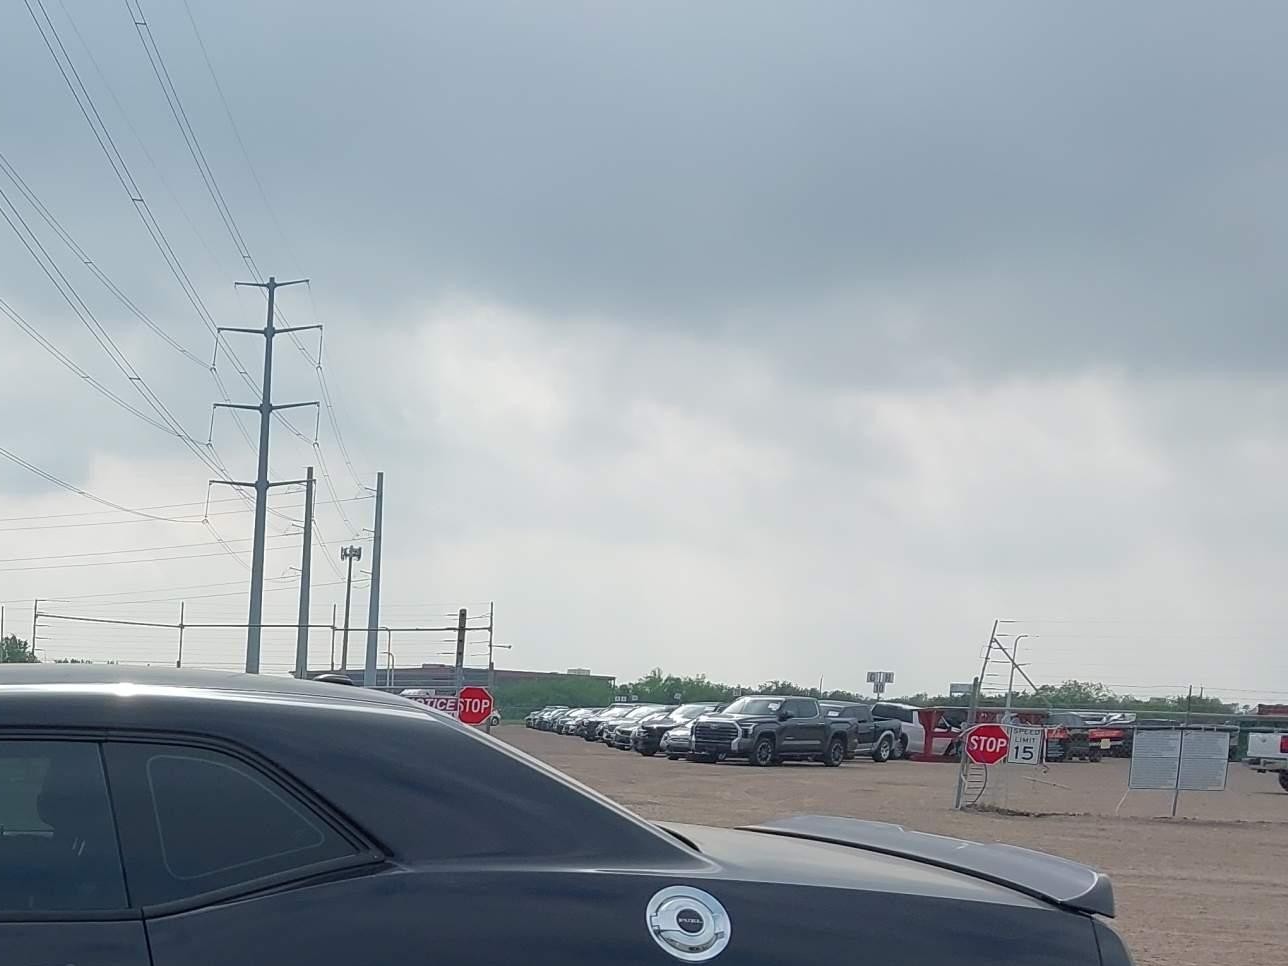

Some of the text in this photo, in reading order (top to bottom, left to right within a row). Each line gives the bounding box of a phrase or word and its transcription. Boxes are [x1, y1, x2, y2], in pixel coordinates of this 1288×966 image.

[412, 698, 456, 710] OTICE
[459, 699, 490, 713] STOP
[970, 735, 1007, 753] STOP
[1014, 746, 1034, 760] 15
